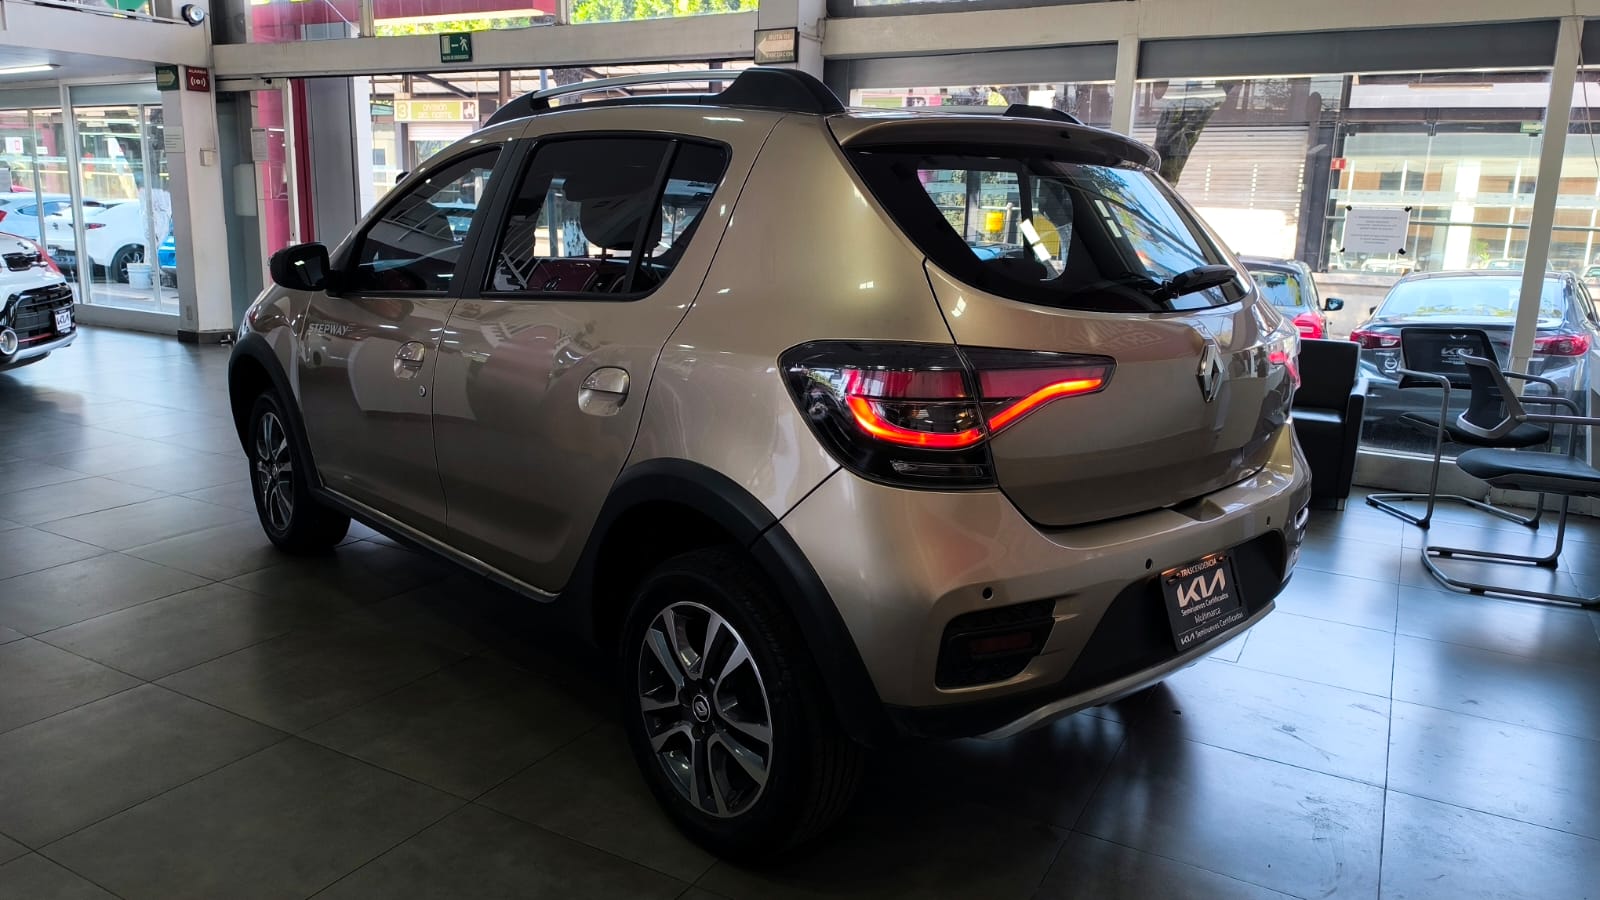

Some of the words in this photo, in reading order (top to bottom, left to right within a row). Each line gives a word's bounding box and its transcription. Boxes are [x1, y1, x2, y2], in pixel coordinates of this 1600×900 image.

[309, 323, 350, 336] STEPWAY
[1180, 558, 1217, 577] TRASCENDENCIA
[1176, 567, 1226, 608] KIA
[1181, 602, 1206, 617] Seminuevos
[1205, 593, 1230, 607] Certificados
[1194, 607, 1221, 624] Multimarca
[1180, 633, 1196, 645] KIA
[1195, 622, 1220, 638] Seminuevos
[1219, 612, 1244, 627] Certificados
